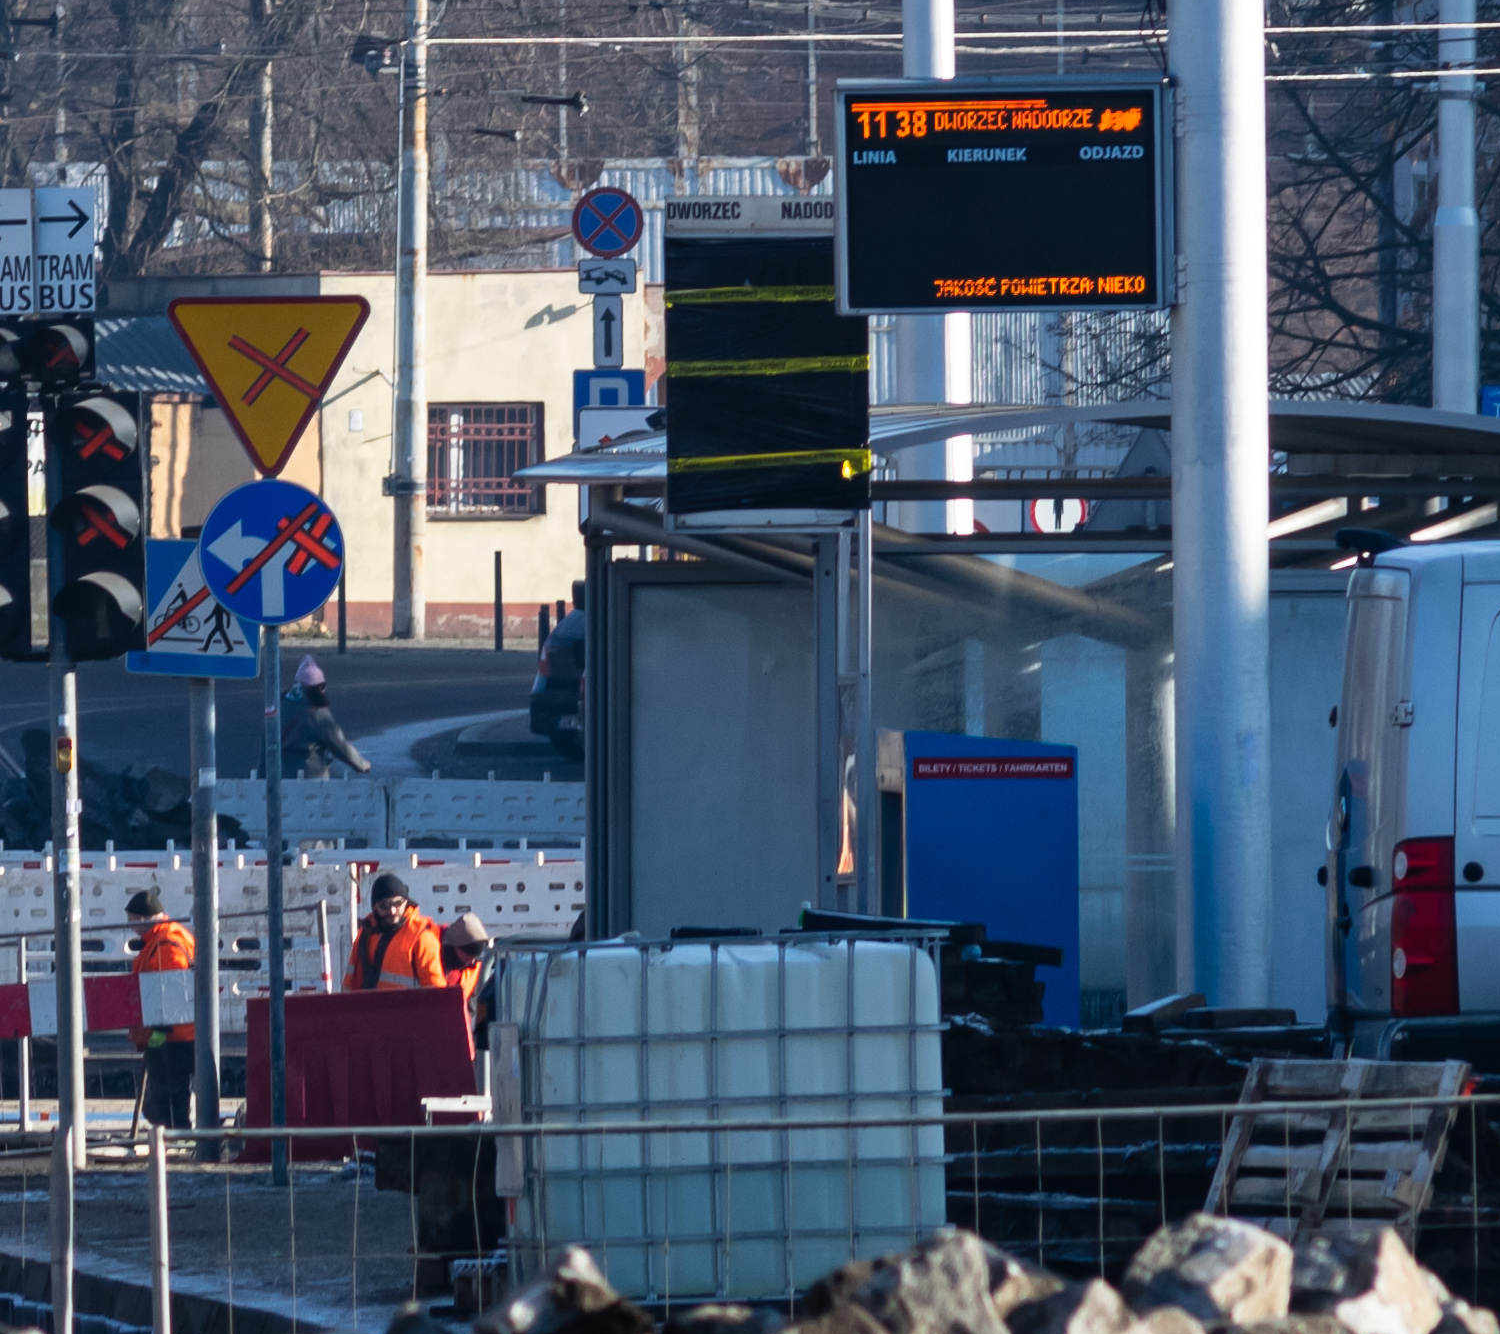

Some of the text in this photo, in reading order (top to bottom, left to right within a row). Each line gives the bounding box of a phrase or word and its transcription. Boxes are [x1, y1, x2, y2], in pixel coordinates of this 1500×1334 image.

[934, 110, 1008, 131] DWORZEC
[1011, 108, 1094, 130] NADODRZE
[853, 145, 1144, 164] LINIA KIERUNEK ODJAZD
[667, 201, 741, 220] DWORZEC
[37, 253, 93, 282] TRAM
[40, 283, 94, 310] BUS
[918, 763, 951, 774] BILETY
[959, 763, 997, 774] TICKETS
[1004, 762, 1068, 773] FAHRKARTEN
